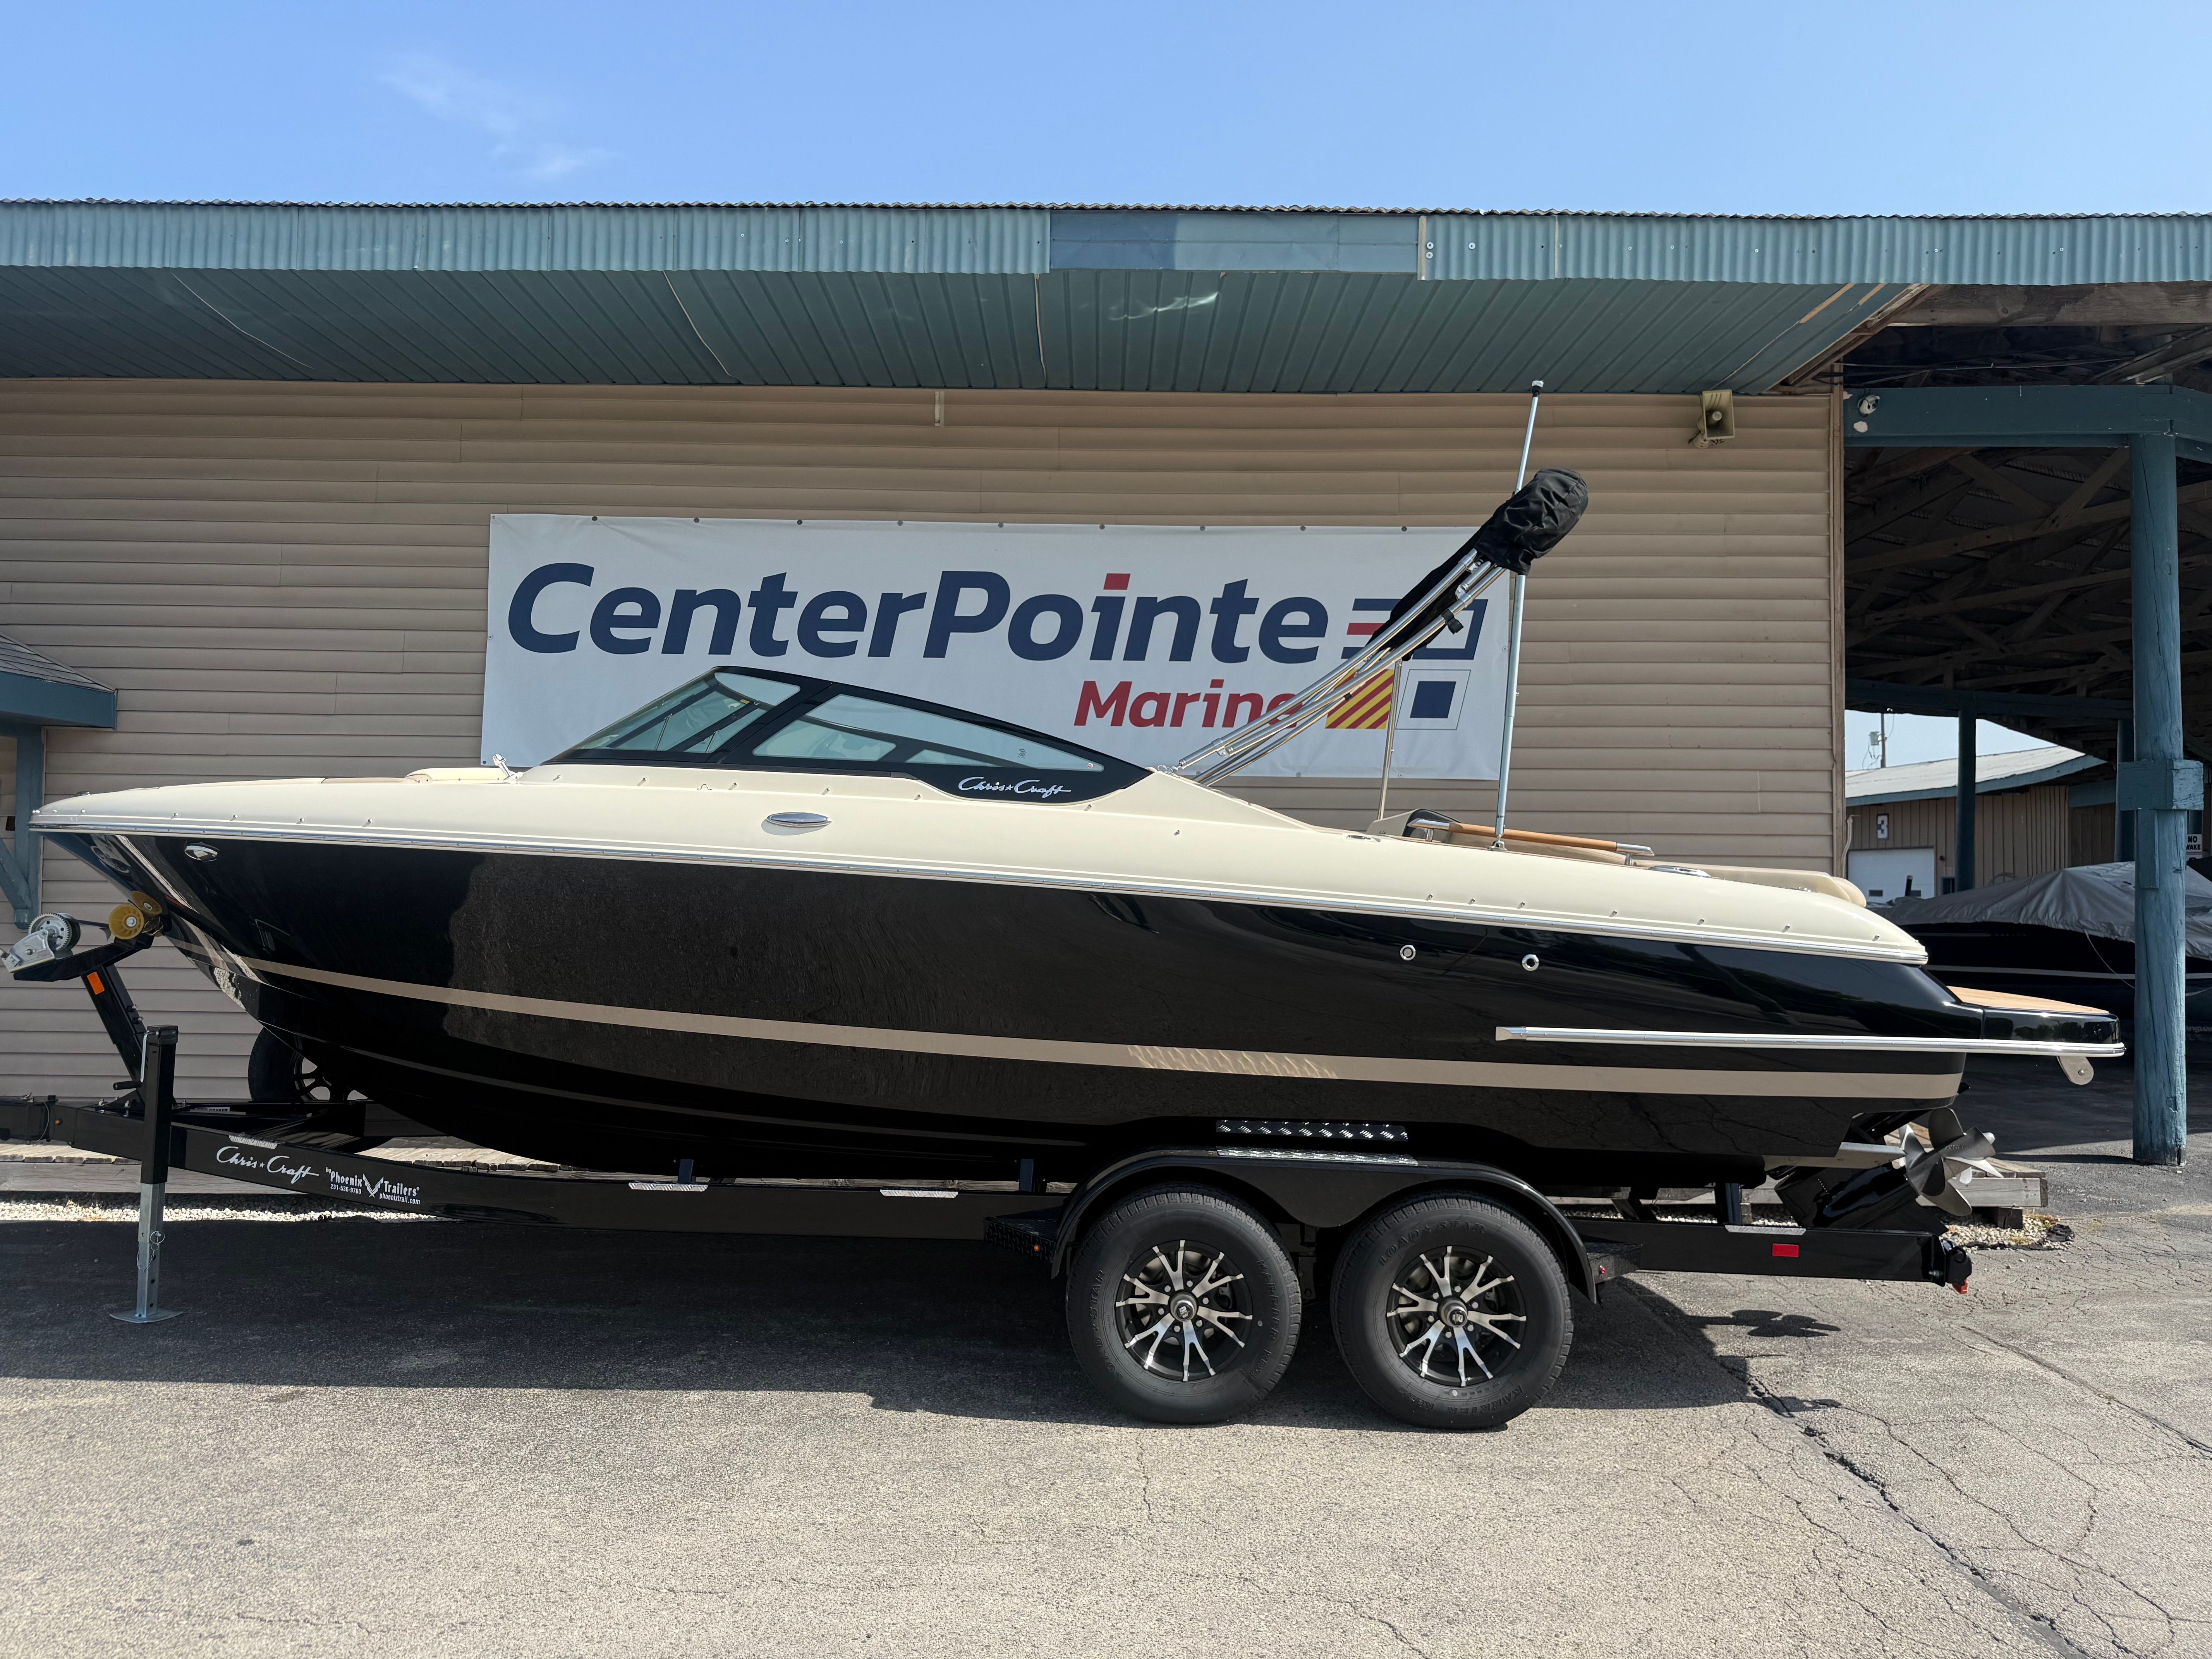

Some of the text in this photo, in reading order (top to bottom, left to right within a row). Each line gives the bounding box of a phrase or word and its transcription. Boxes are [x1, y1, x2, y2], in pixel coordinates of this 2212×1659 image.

[508, 562, 1328, 664] CenterPointe
[958, 776, 1072, 798] Chris Craft
[1877, 815, 1888, 839] 3
[216, 1146, 319, 1184] Chris Craft
[330, 1171, 362, 1187] Phoenix
[379, 1192, 421, 1205] phoenixtrail.com
